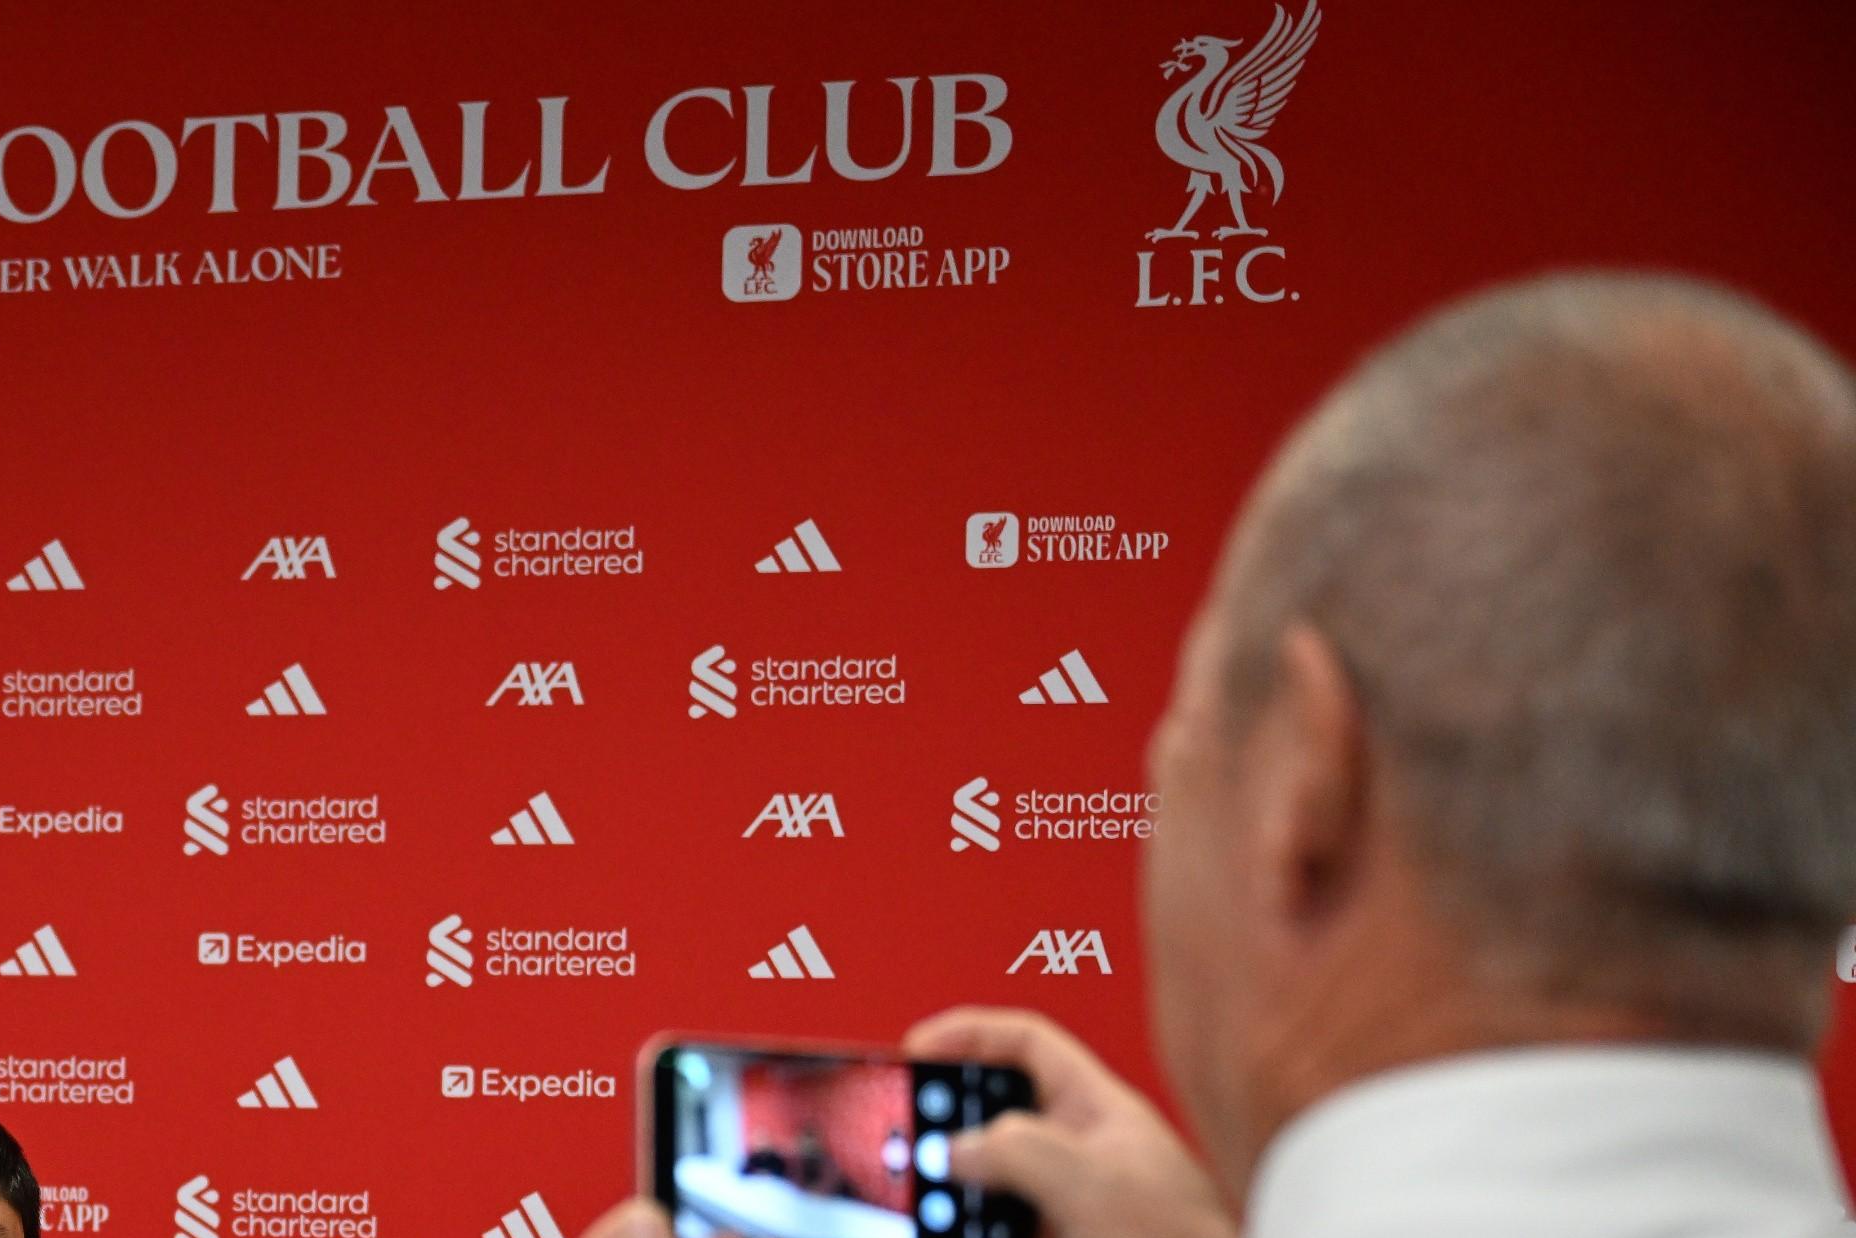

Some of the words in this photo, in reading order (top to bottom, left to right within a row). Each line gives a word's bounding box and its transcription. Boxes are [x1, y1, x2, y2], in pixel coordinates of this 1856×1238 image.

[644, 73, 1013, 190] CLUB
[813, 226, 923, 251] DOWNLOAD
[63, 252, 183, 290] WALK
[192, 244, 342, 284] ALONE
[813, 250, 928, 292] STORE
[936, 247, 1010, 286] APP
[1135, 245, 1301, 308] L.F.C.
[1028, 515, 1115, 533] DOWNLOAD
[495, 526, 634, 553] standard
[1027, 533, 1111, 562] STORE
[1115, 532, 1169, 560] APP
[241, 536, 337, 580] AXA
[494, 550, 643, 577] chartered
[751, 654, 896, 681] standard
[3, 668, 134, 695] standard
[485, 661, 584, 707] AXA
[751, 680, 905, 706] chartered
[2, 693, 142, 717] chartered
[242, 795, 378, 821] standard
[742, 793, 845, 838] AXA
[241, 820, 386, 844] chartered
[236, 934, 367, 968] Expedia
[486, 927, 627, 952] standard
[1006, 929, 1112, 975] AXA
[486, 952, 636, 976] chartered
[481, 1068, 616, 1102] Expedia
[233, 1189, 369, 1215] standard
[56, 1203, 110, 1232] APP
[231, 1215, 377, 1238] chartered
